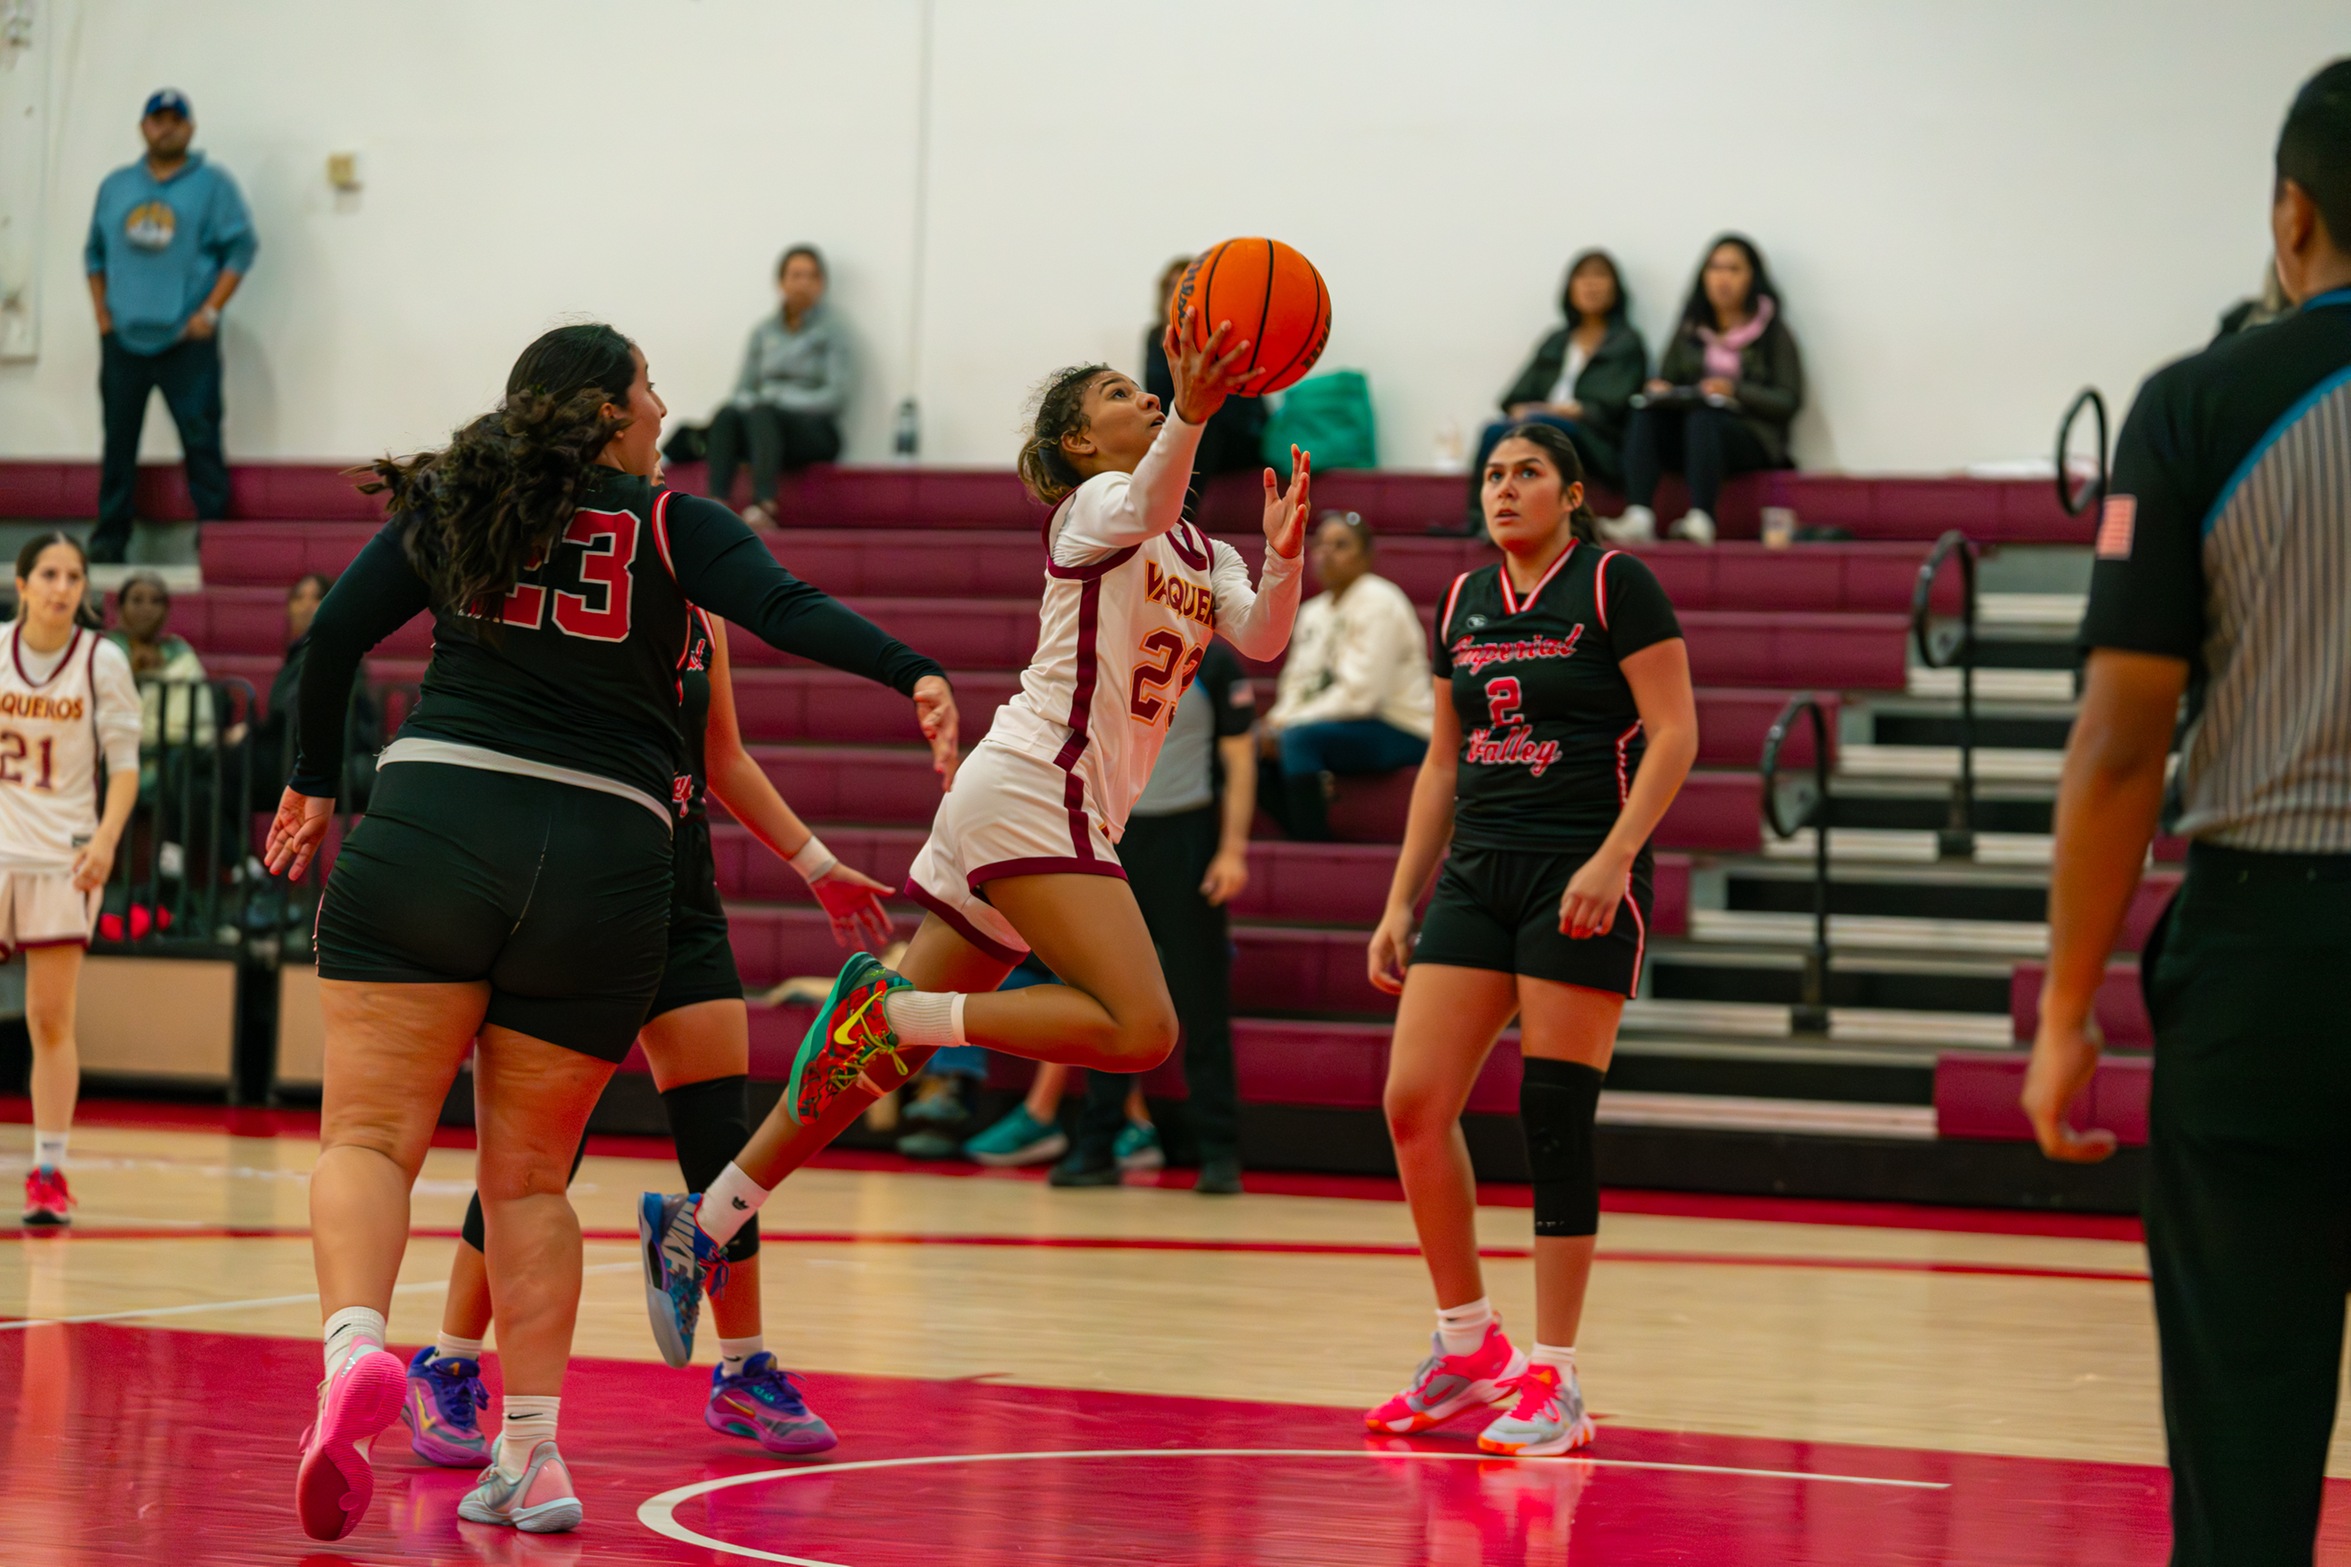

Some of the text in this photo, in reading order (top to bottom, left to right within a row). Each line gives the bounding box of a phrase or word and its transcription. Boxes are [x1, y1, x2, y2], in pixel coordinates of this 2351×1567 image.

[0, 691, 83, 721] QUEROS
[1484, 676, 1524, 730] 2
[0, 727, 56, 794] 21
[1467, 724, 1563, 777] Valley
